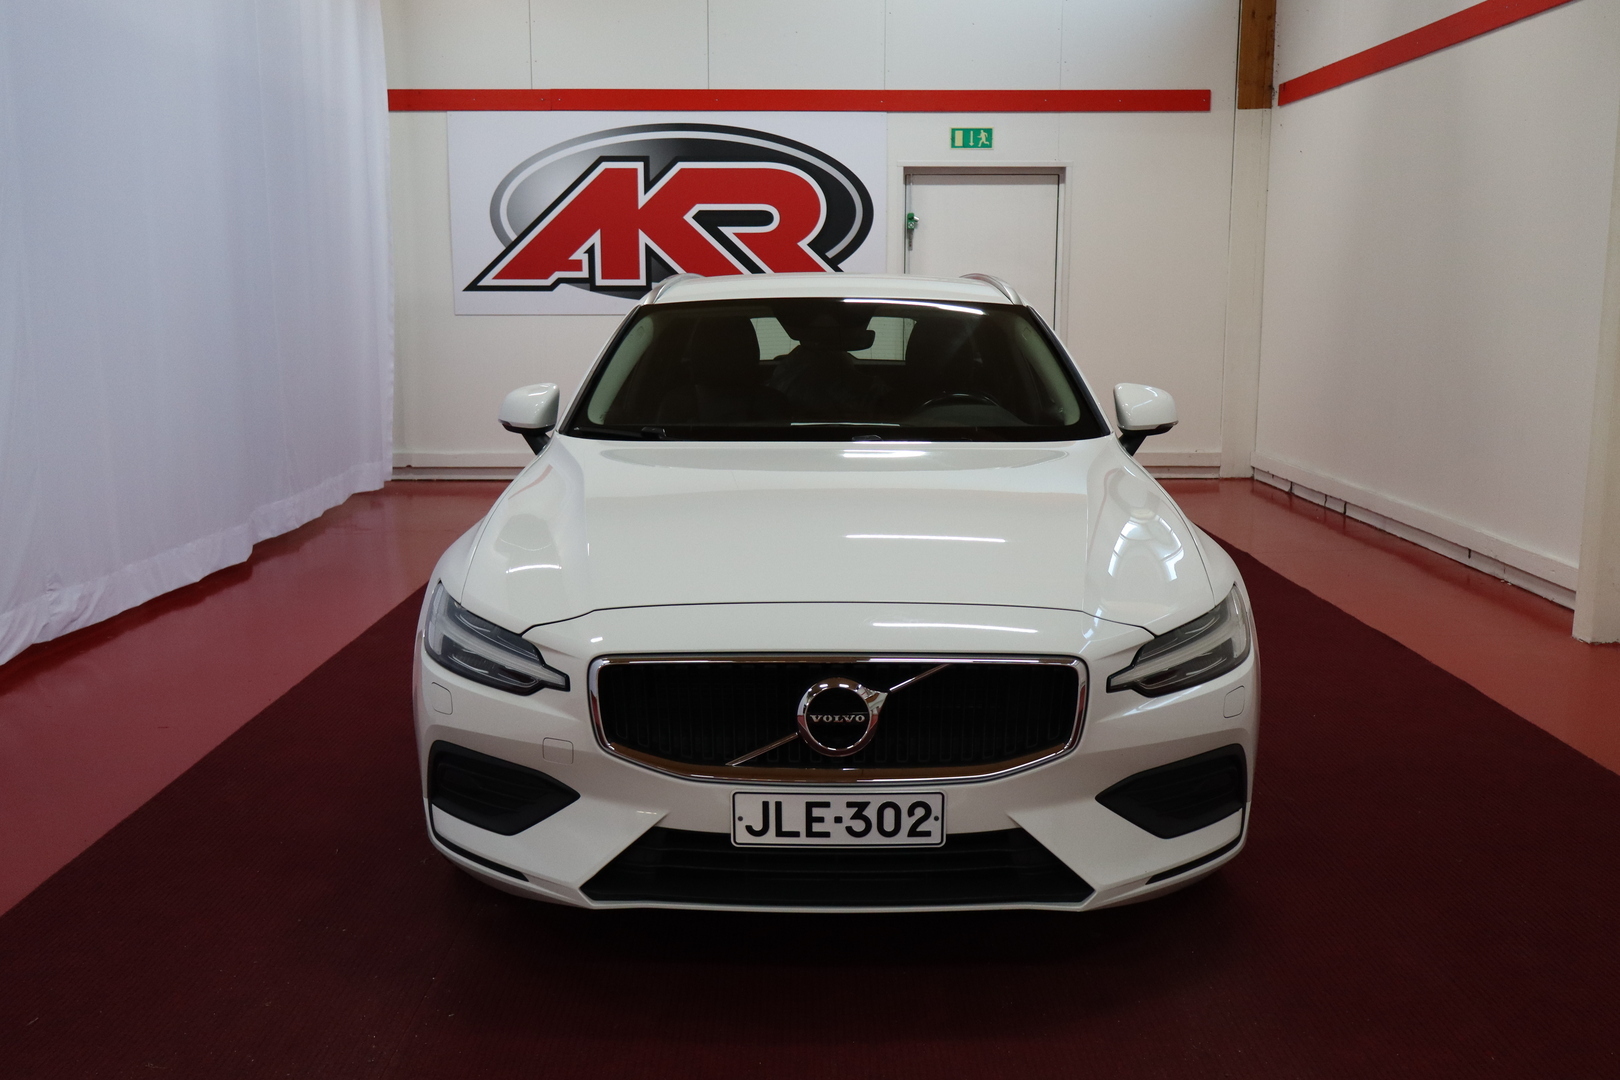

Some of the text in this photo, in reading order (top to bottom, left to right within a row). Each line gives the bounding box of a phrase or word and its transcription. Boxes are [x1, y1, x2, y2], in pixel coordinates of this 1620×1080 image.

[464, 156, 842, 291] AKR
[810, 714, 865, 722] VOLVO
[744, 800, 932, 838] JLE-302
